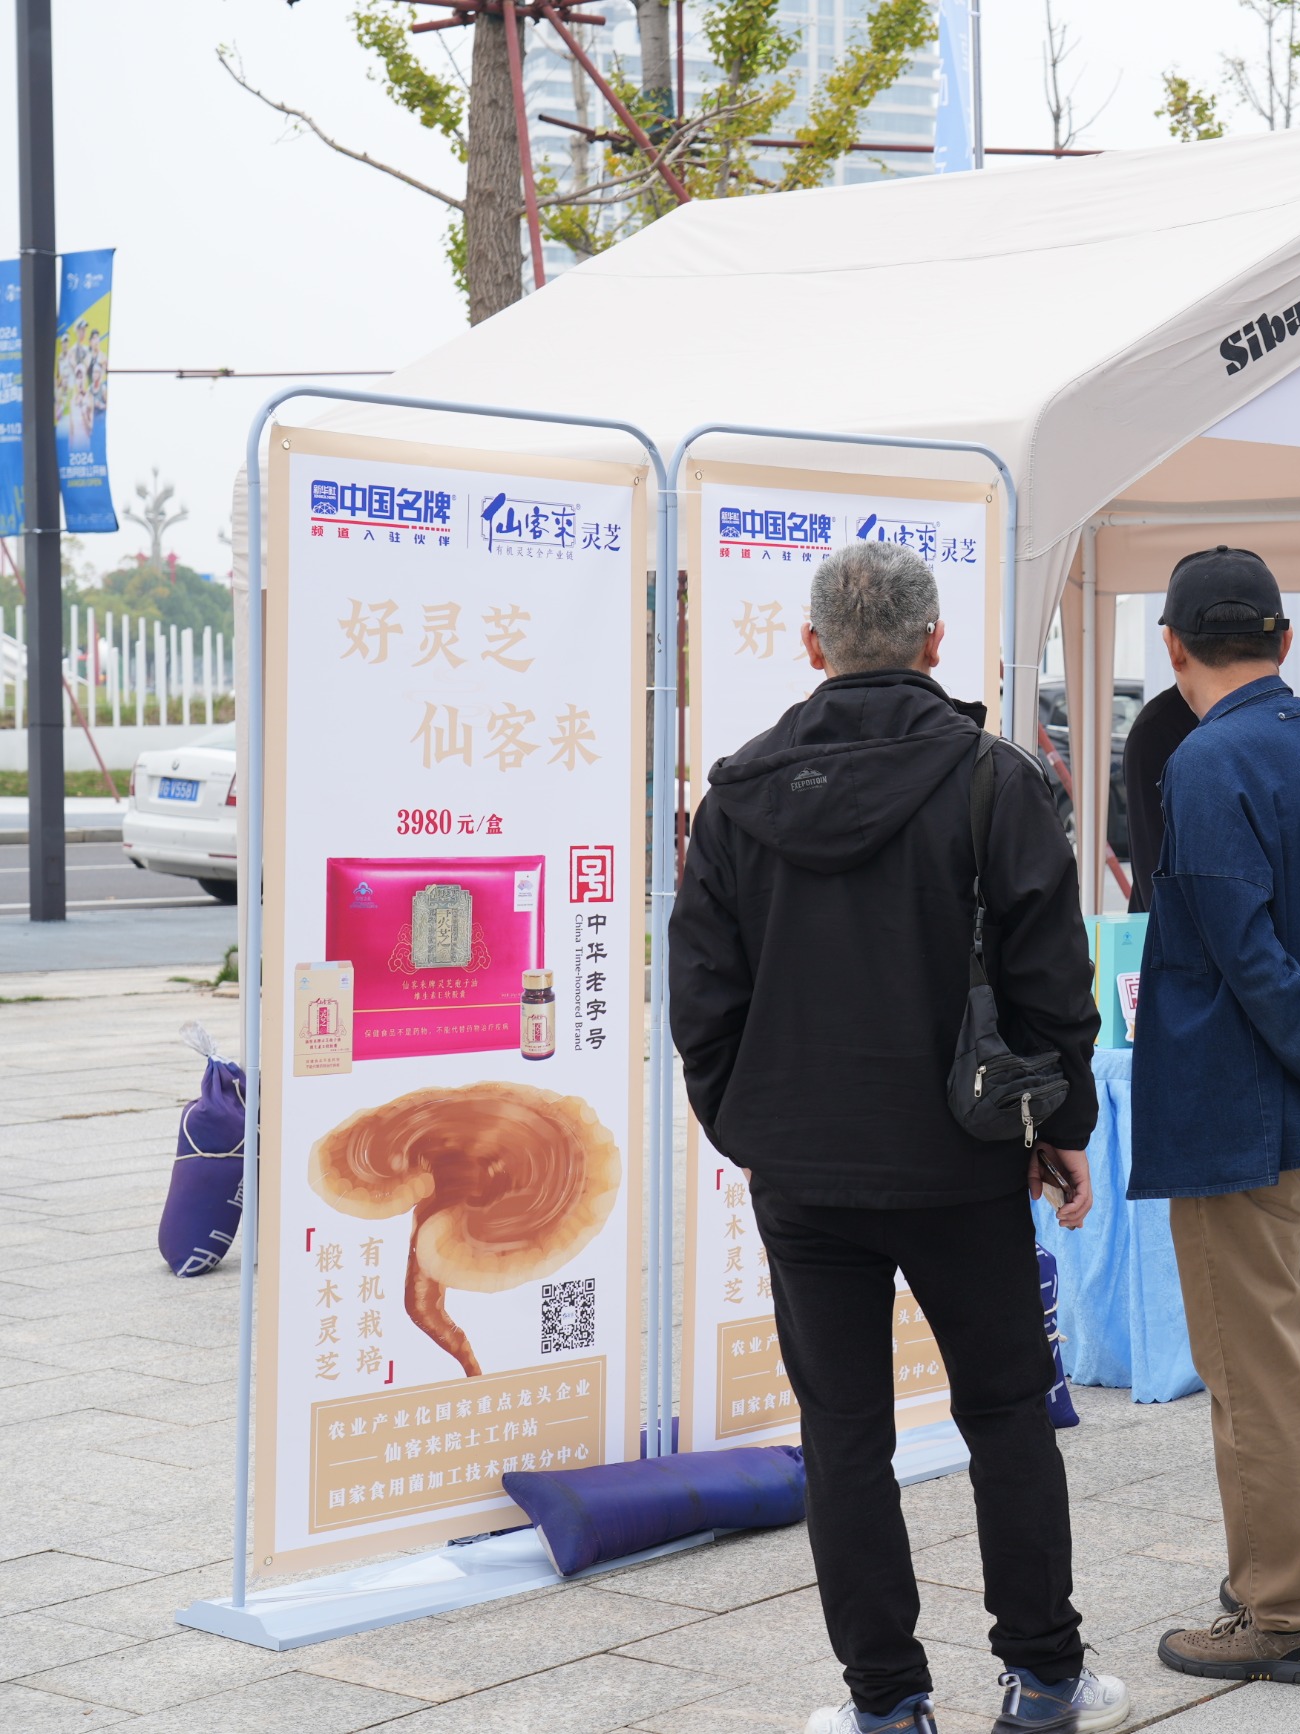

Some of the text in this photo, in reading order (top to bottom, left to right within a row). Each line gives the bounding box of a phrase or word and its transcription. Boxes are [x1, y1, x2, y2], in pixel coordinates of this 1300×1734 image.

[340, 483, 451, 525] 中国名牌
[742, 509, 832, 544] 中国名牌
[311, 525, 450, 548] 频道入驻伙伴
[581, 522, 622, 552] 灵芝
[941, 537, 977, 563] 灵芝
[337, 597, 536, 673] 好灵芝
[410, 700, 603, 772] 仙客来
[574, 914, 582, 1052] China Time-honored Brand
[585, 913, 608, 1051] 中华老字号
[328, 1377, 591, 1441] 农业产业化国家重点龙头企业
[731, 1389, 800, 1418] 国家食用
[384, 1417, 539, 1464] 仙客来院士工作站
[328, 1444, 590, 1510] 国家食用菌加工技术研发分中心
